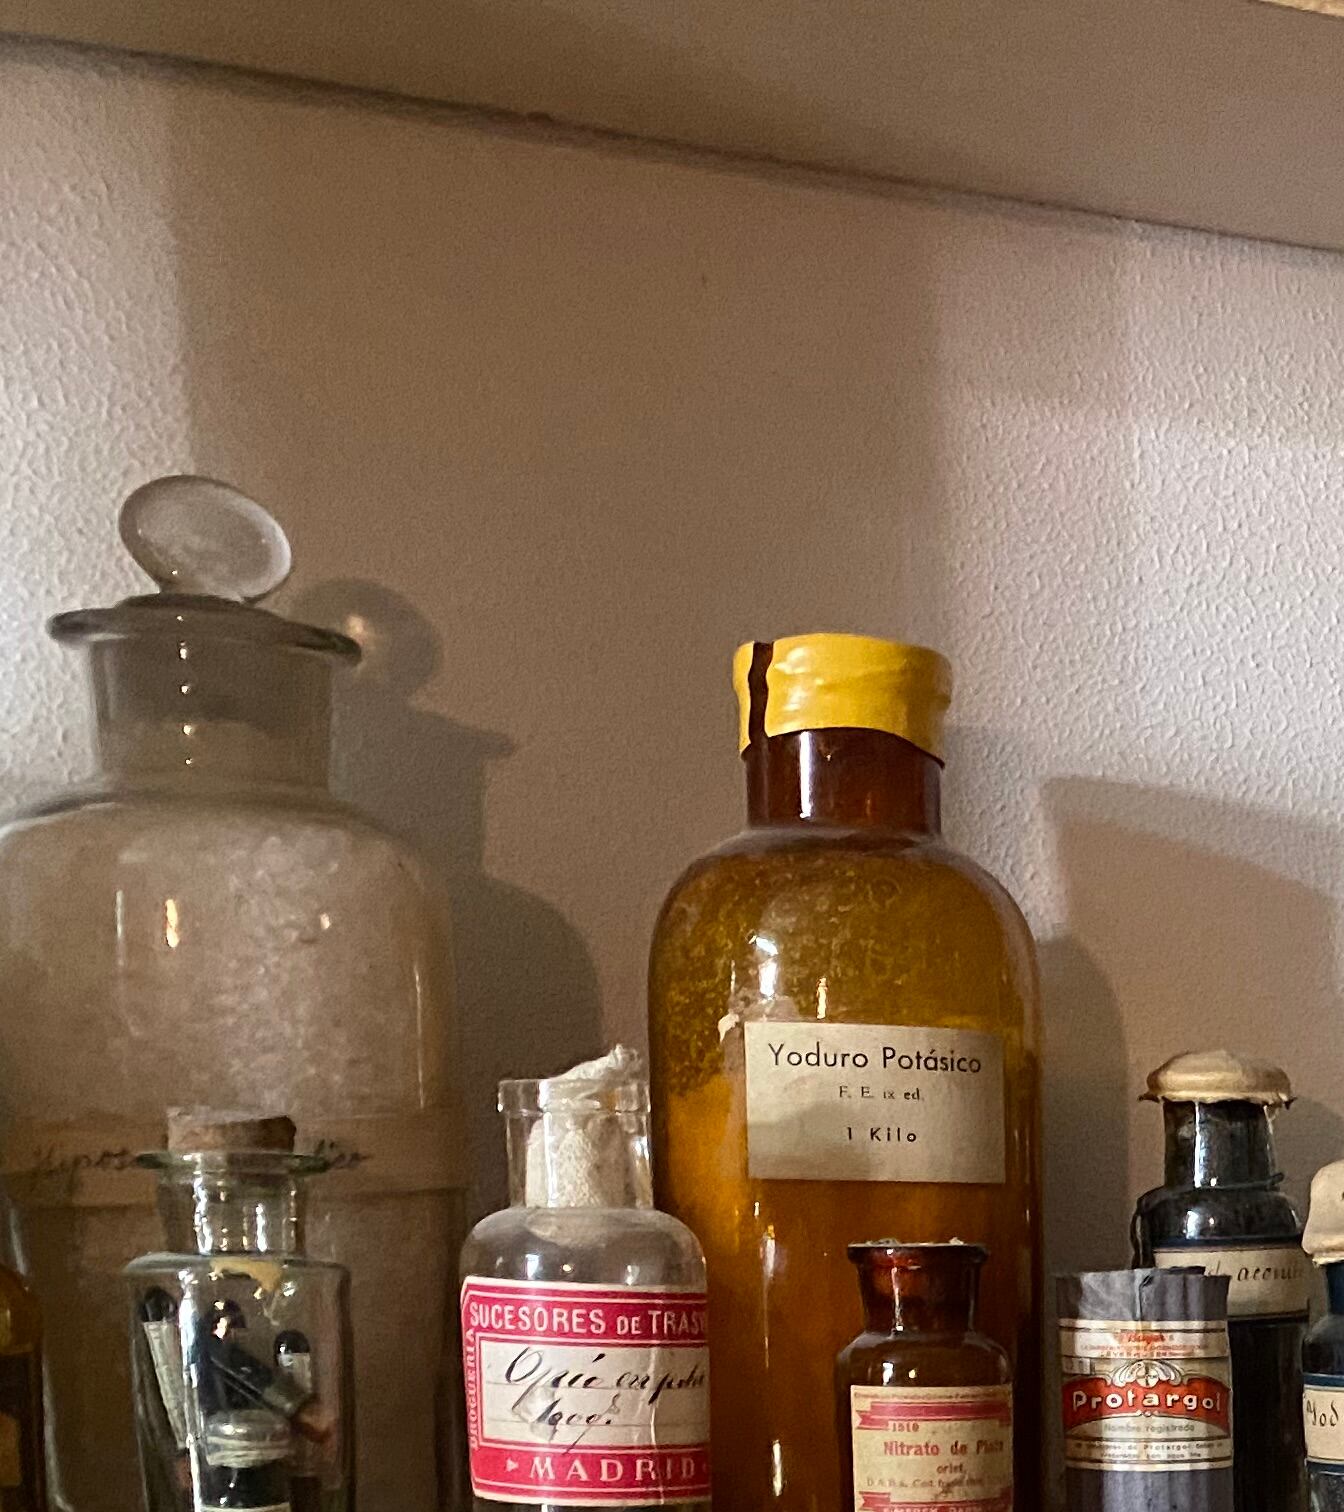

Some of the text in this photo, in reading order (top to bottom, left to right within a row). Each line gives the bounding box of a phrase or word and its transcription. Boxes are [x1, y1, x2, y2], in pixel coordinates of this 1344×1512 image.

[768, 1041, 982, 1074] Yoduro Potásico
[847, 1126, 917, 1143] 1 Kilo
[469, 1302, 607, 1335] SUCESORES
[616, 1314, 642, 1335] DE
[1072, 1390, 1221, 1412] Protargol
[883, 1440, 941, 1457] Nitrato
[950, 1440, 968, 1457] de
[529, 1456, 696, 1482] MADRID
